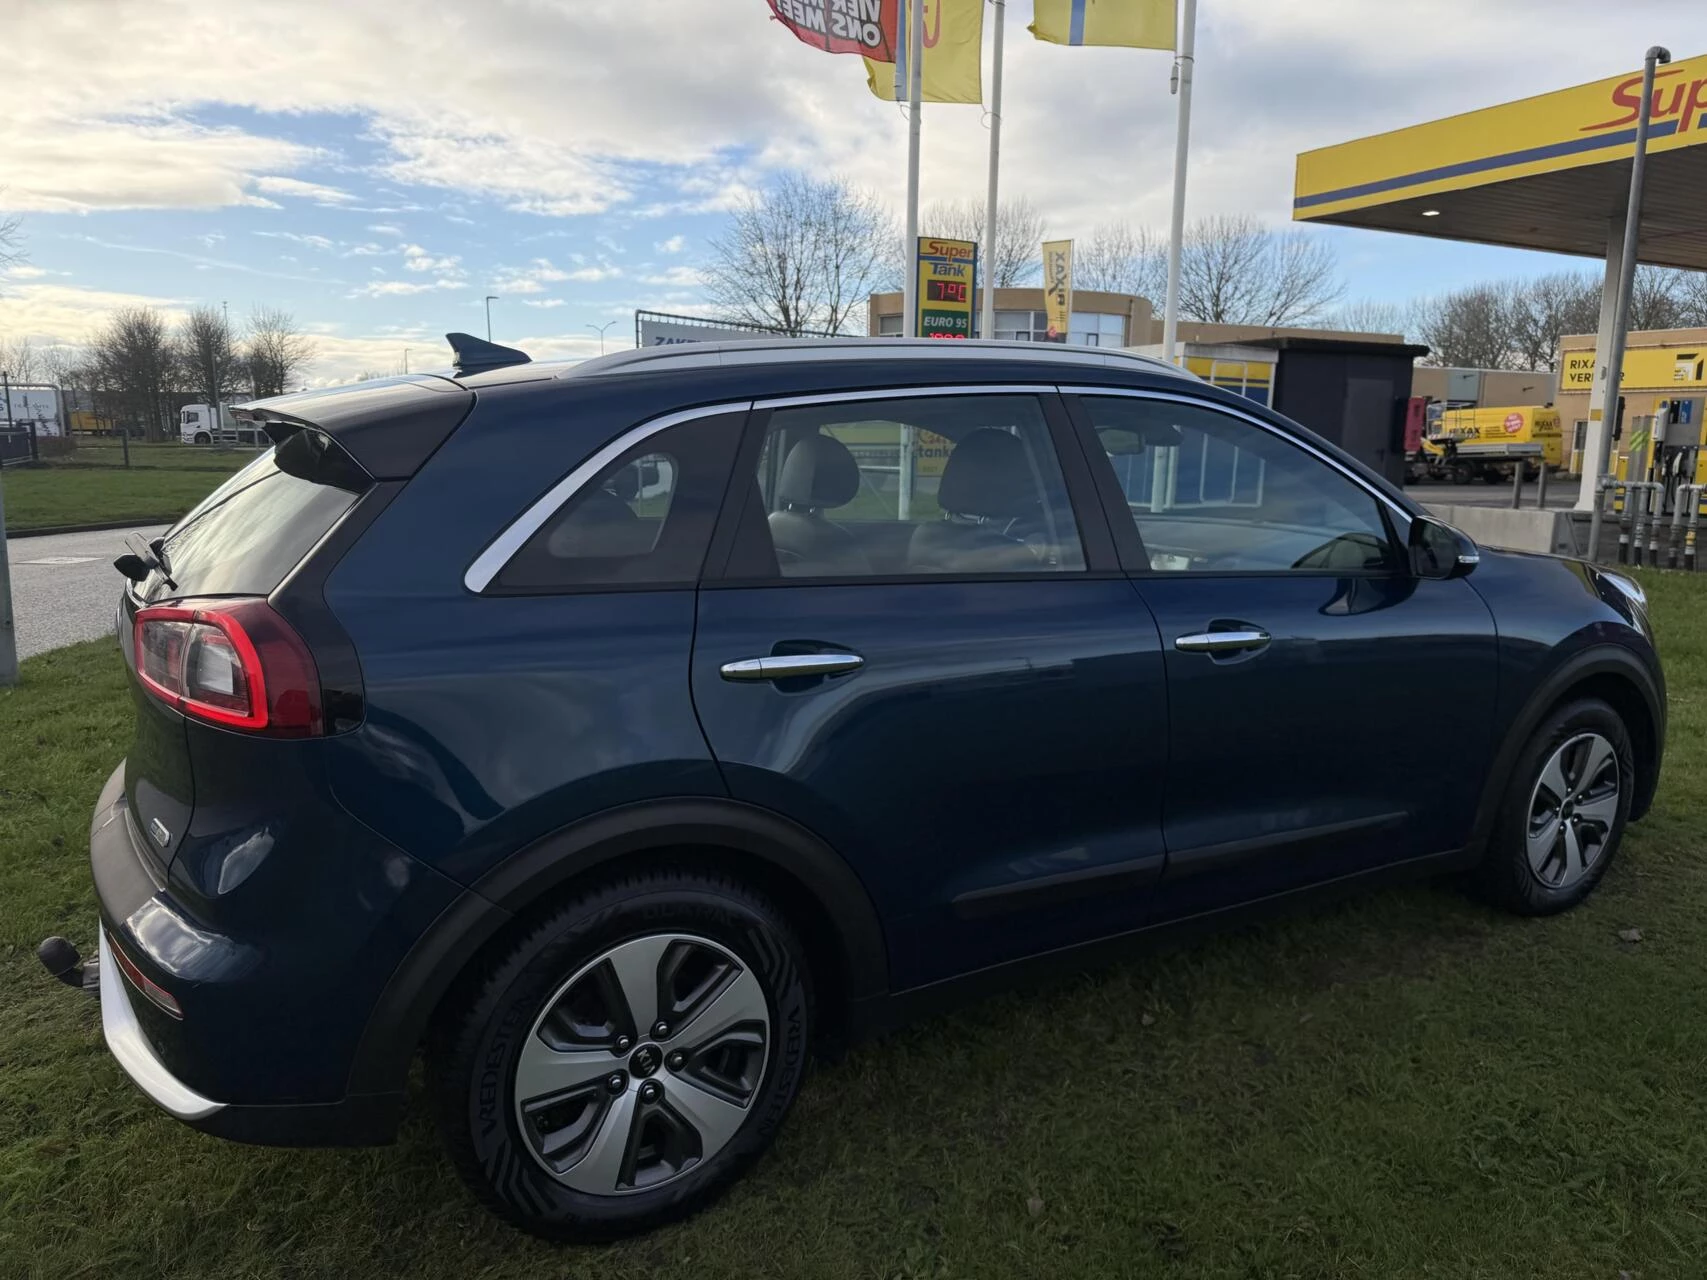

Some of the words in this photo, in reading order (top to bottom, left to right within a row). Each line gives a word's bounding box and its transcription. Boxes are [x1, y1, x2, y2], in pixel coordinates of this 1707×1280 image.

[921, 241, 973, 262] Super
[928, 262, 966, 277] Tank
[924, 316, 953, 327] EURO
[955, 318, 968, 328] 95
[1570, 359, 1596, 369] RIXA
